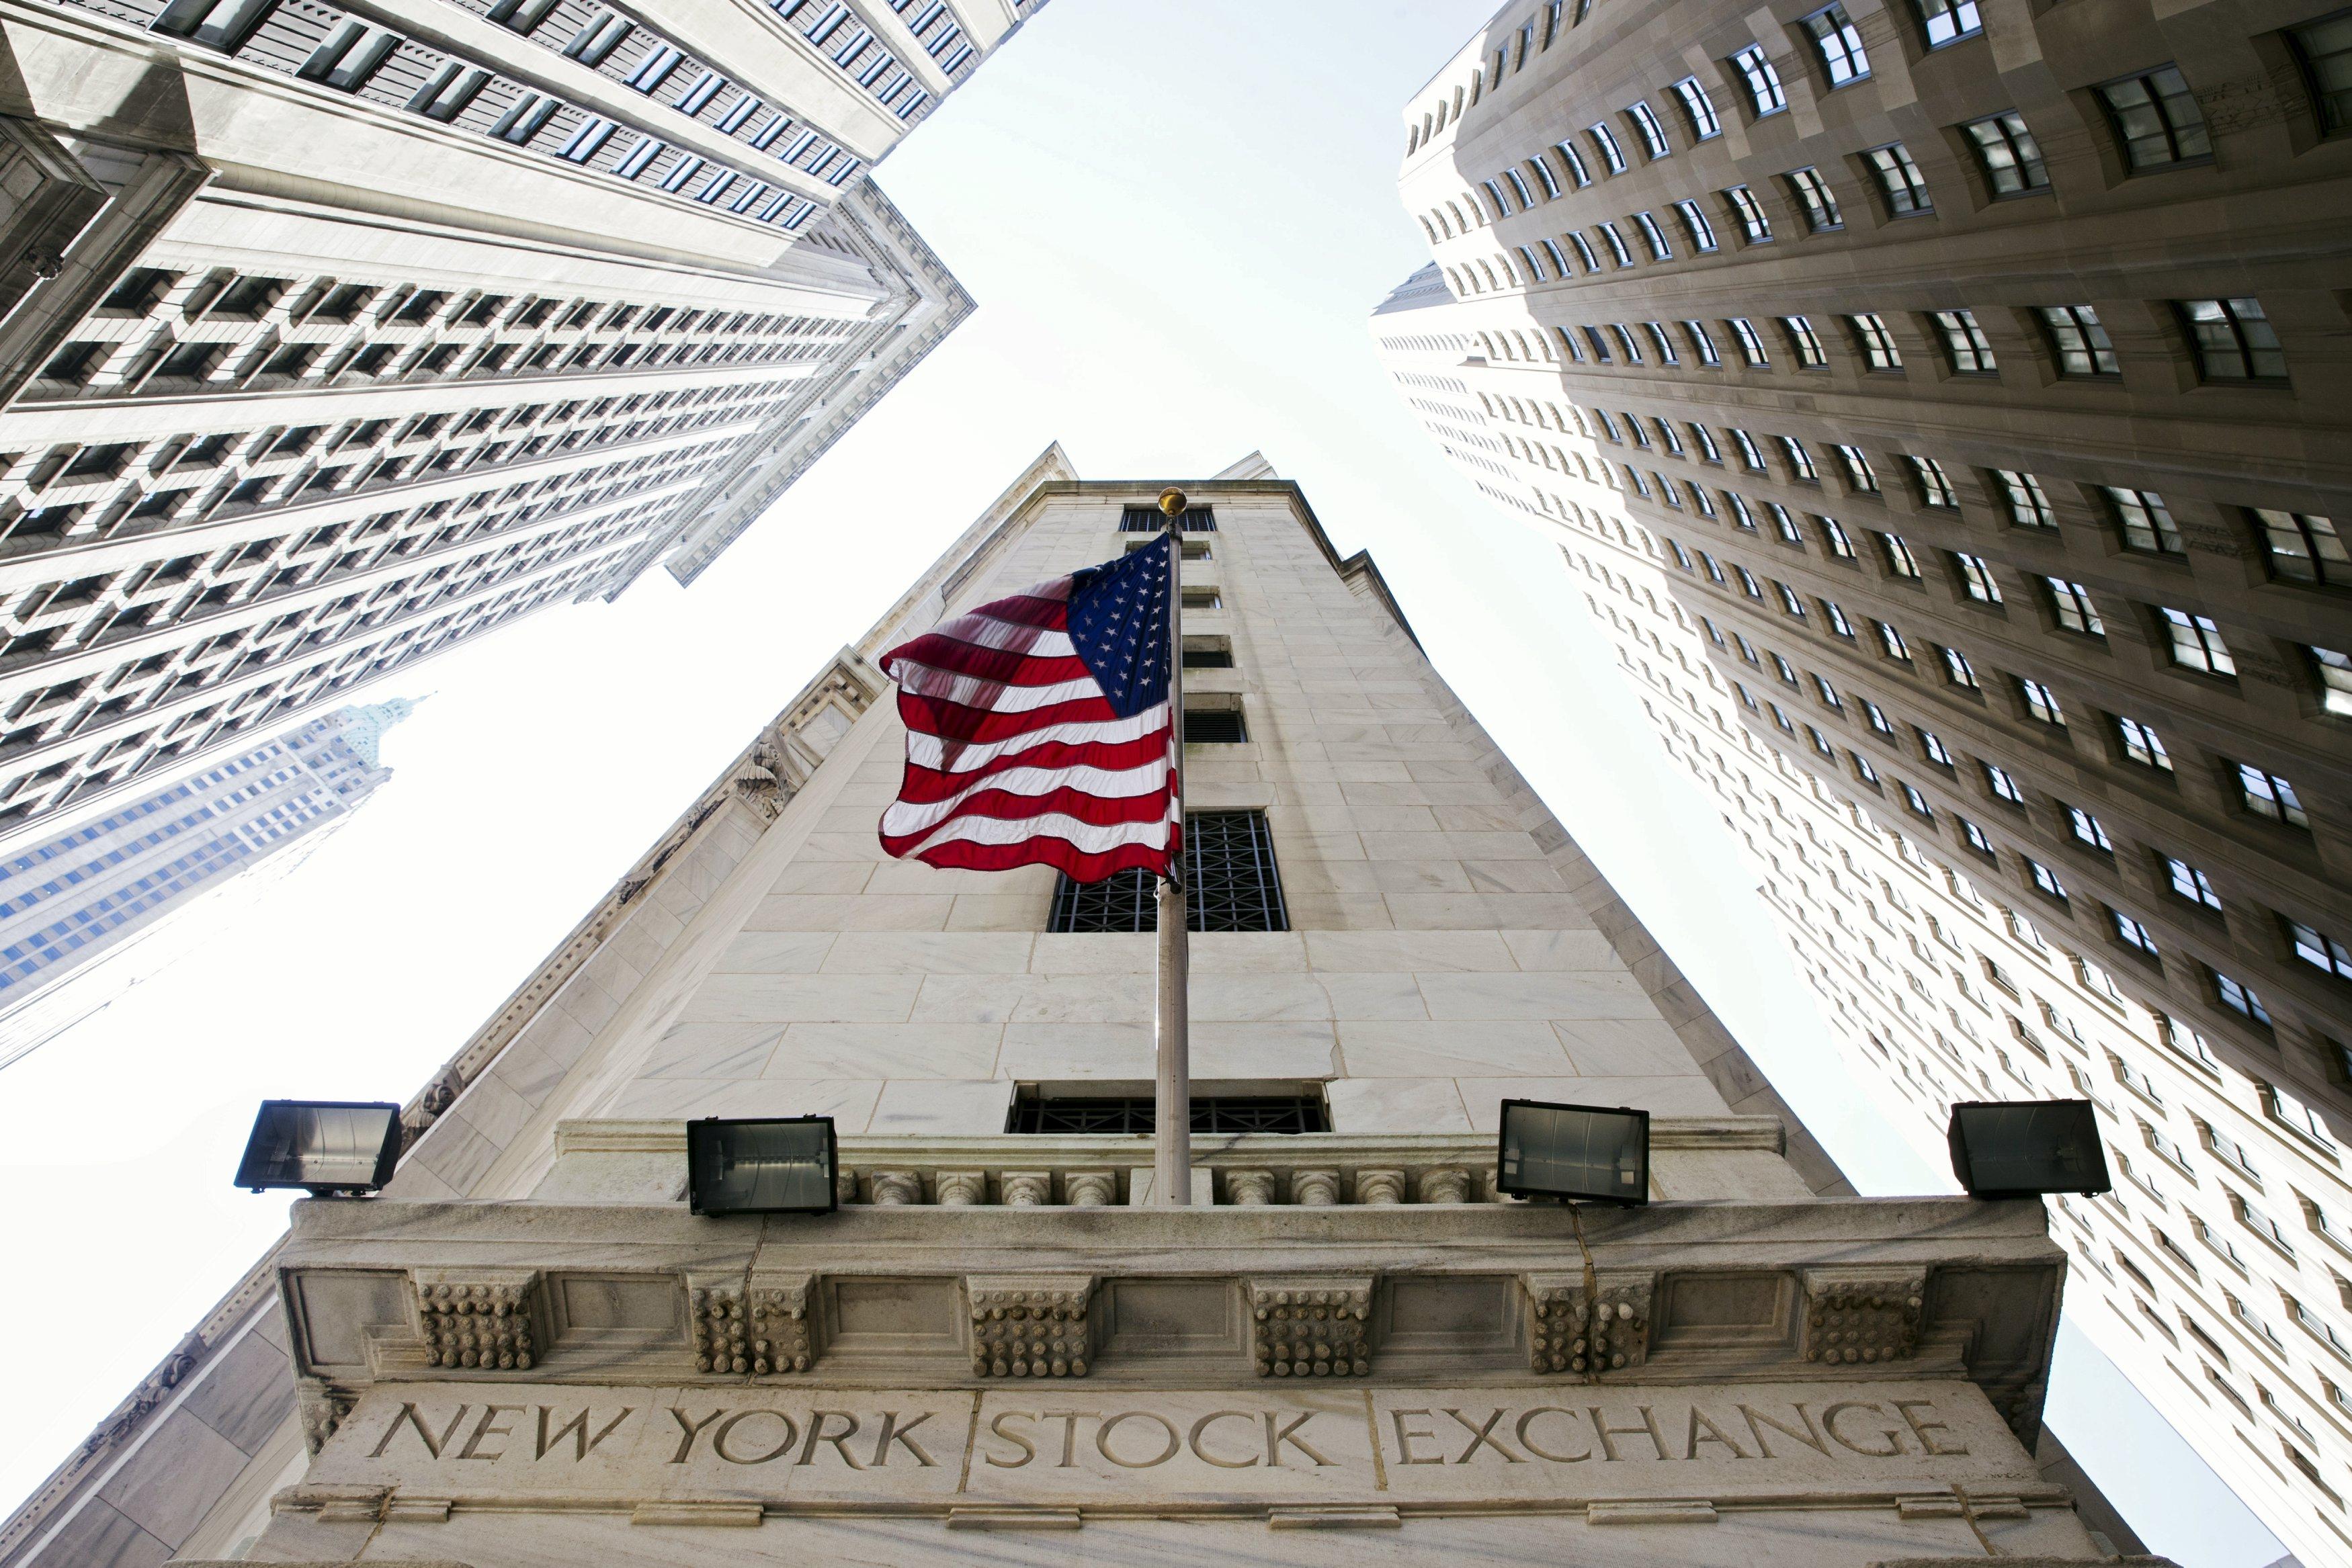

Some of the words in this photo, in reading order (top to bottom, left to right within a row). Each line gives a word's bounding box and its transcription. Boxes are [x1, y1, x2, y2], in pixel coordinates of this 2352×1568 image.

[367, 1402, 636, 1462] NEW
[664, 1406, 943, 1470] YORK
[985, 1409, 1342, 1469] STOCK
[1389, 1400, 1970, 1465] EXCHANGE
